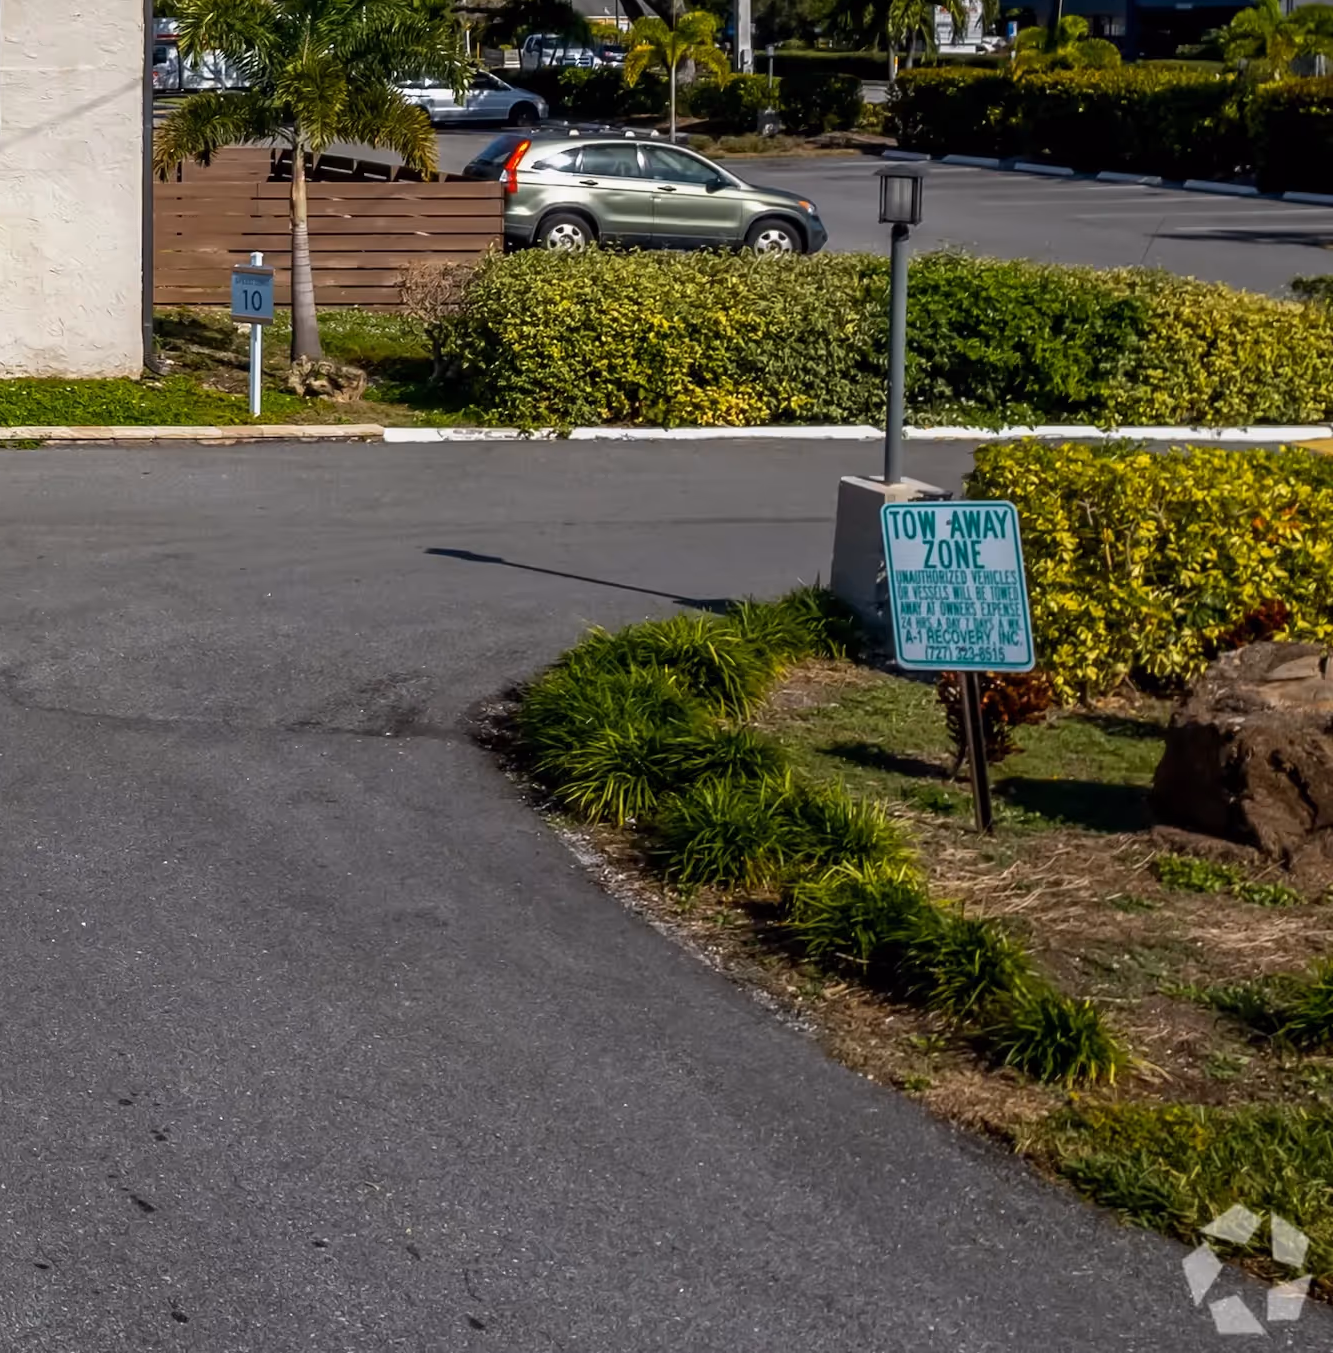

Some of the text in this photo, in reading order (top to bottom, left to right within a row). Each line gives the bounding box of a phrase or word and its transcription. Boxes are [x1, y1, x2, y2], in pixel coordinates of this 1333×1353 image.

[242, 289, 263, 311] 10
[889, 510, 1009, 540] TOW AWAY
[922, 540, 986, 569] ZONE
[896, 570, 1018, 585] UNAUTHORIZED VEHICLES
[898, 586, 1019, 601] OR VESSELS WILL BE TOWED
[900, 601, 922, 616] AWAY
[926, 601, 935, 616] AT
[981, 601, 1021, 616] EXPENSE
[901, 617, 912, 629] 24
[905, 629, 923, 643] A-1
[998, 630, 1023, 646] INC.
[925, 646, 952, 660] (727)
